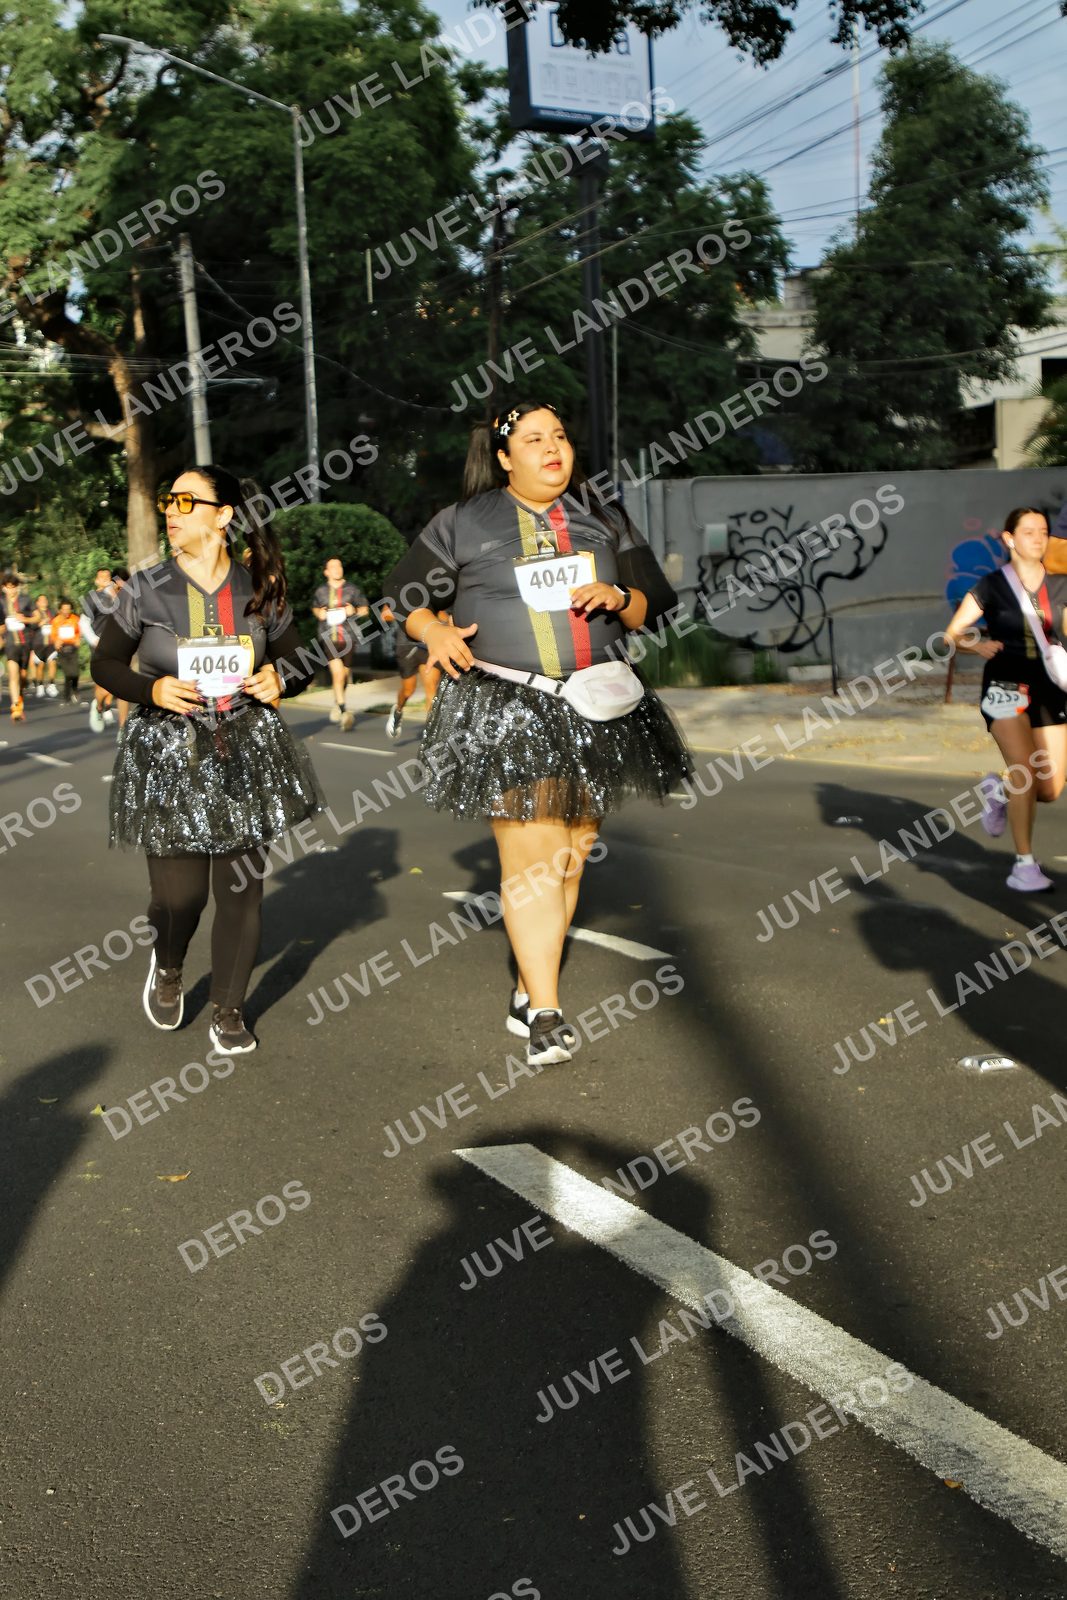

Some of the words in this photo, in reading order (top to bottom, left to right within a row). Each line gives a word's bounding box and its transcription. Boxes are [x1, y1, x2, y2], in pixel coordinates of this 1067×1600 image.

[728, 505, 794, 531] TOY
[530, 564, 578, 589] 4047
[190, 655, 239, 674] 4046
